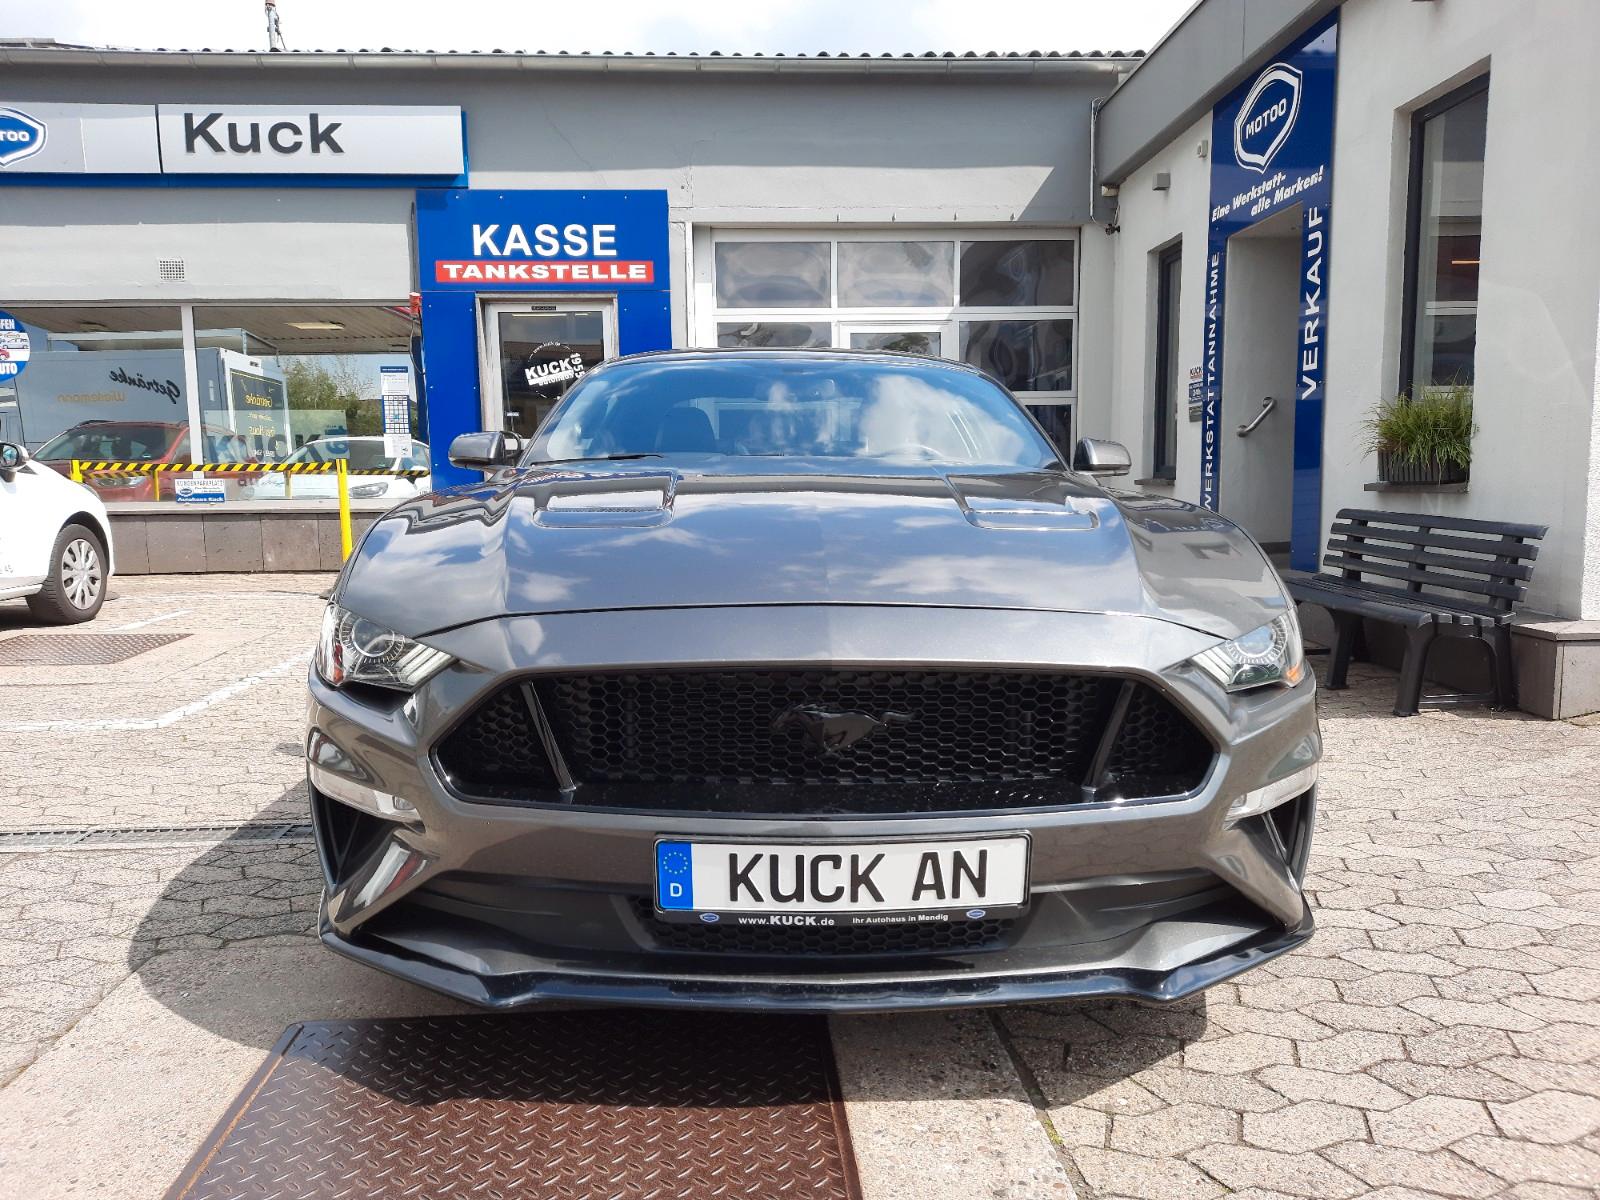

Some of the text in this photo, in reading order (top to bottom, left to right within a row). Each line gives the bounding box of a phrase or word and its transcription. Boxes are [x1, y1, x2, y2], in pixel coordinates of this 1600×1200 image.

[184, 112, 345, 154] Kuck
[1246, 98, 1286, 140] MOTOO
[1211, 172, 1286, 223] Eine Werkstatt-
[1251, 165, 1324, 217] alle Marken!
[472, 224, 618, 257] KASSE
[443, 264, 647, 280] TANKSTELLE
[1301, 206, 1324, 401] VERKAUF
[524, 357, 574, 381] KUCK
[1202, 251, 1220, 511] WERKSTATTANNAHME
[670, 883, 682, 897] D
[729, 850, 988, 904] KUCK AN
[738, 915, 835, 926] www.KUCK.de
[866, 916, 906, 924] Autohaus
[918, 914, 949, 923] Mendig
